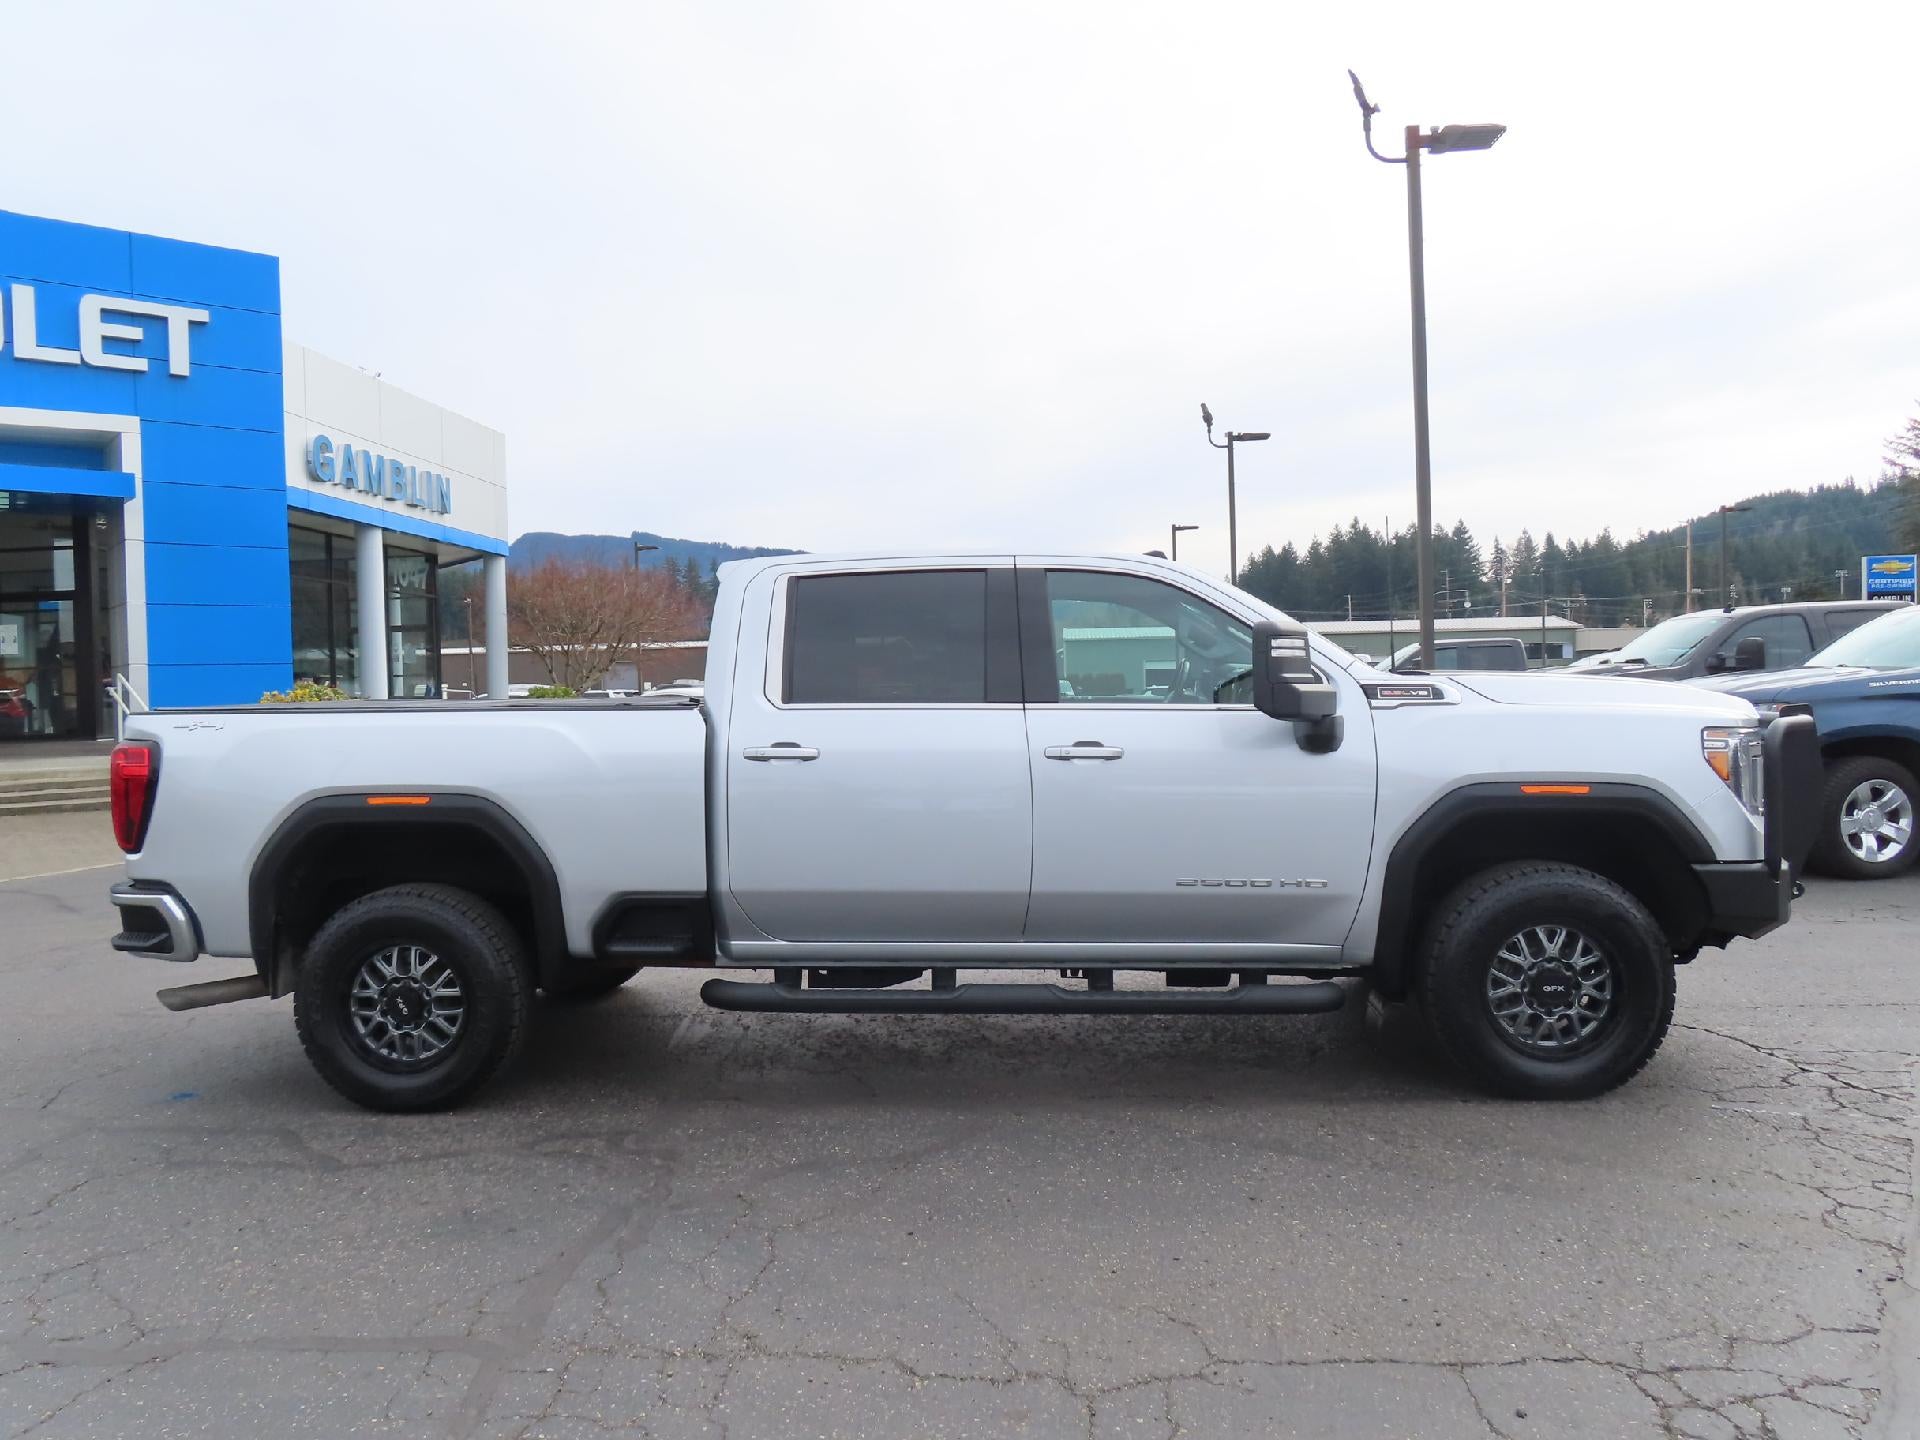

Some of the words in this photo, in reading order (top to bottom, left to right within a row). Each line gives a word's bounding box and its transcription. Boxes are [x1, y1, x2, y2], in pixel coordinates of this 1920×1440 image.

[0, 283, 210, 377] LET
[308, 434, 451, 514] GAMBLIN
[1175, 877, 1273, 888] 2500
[1279, 878, 1329, 888] HD
